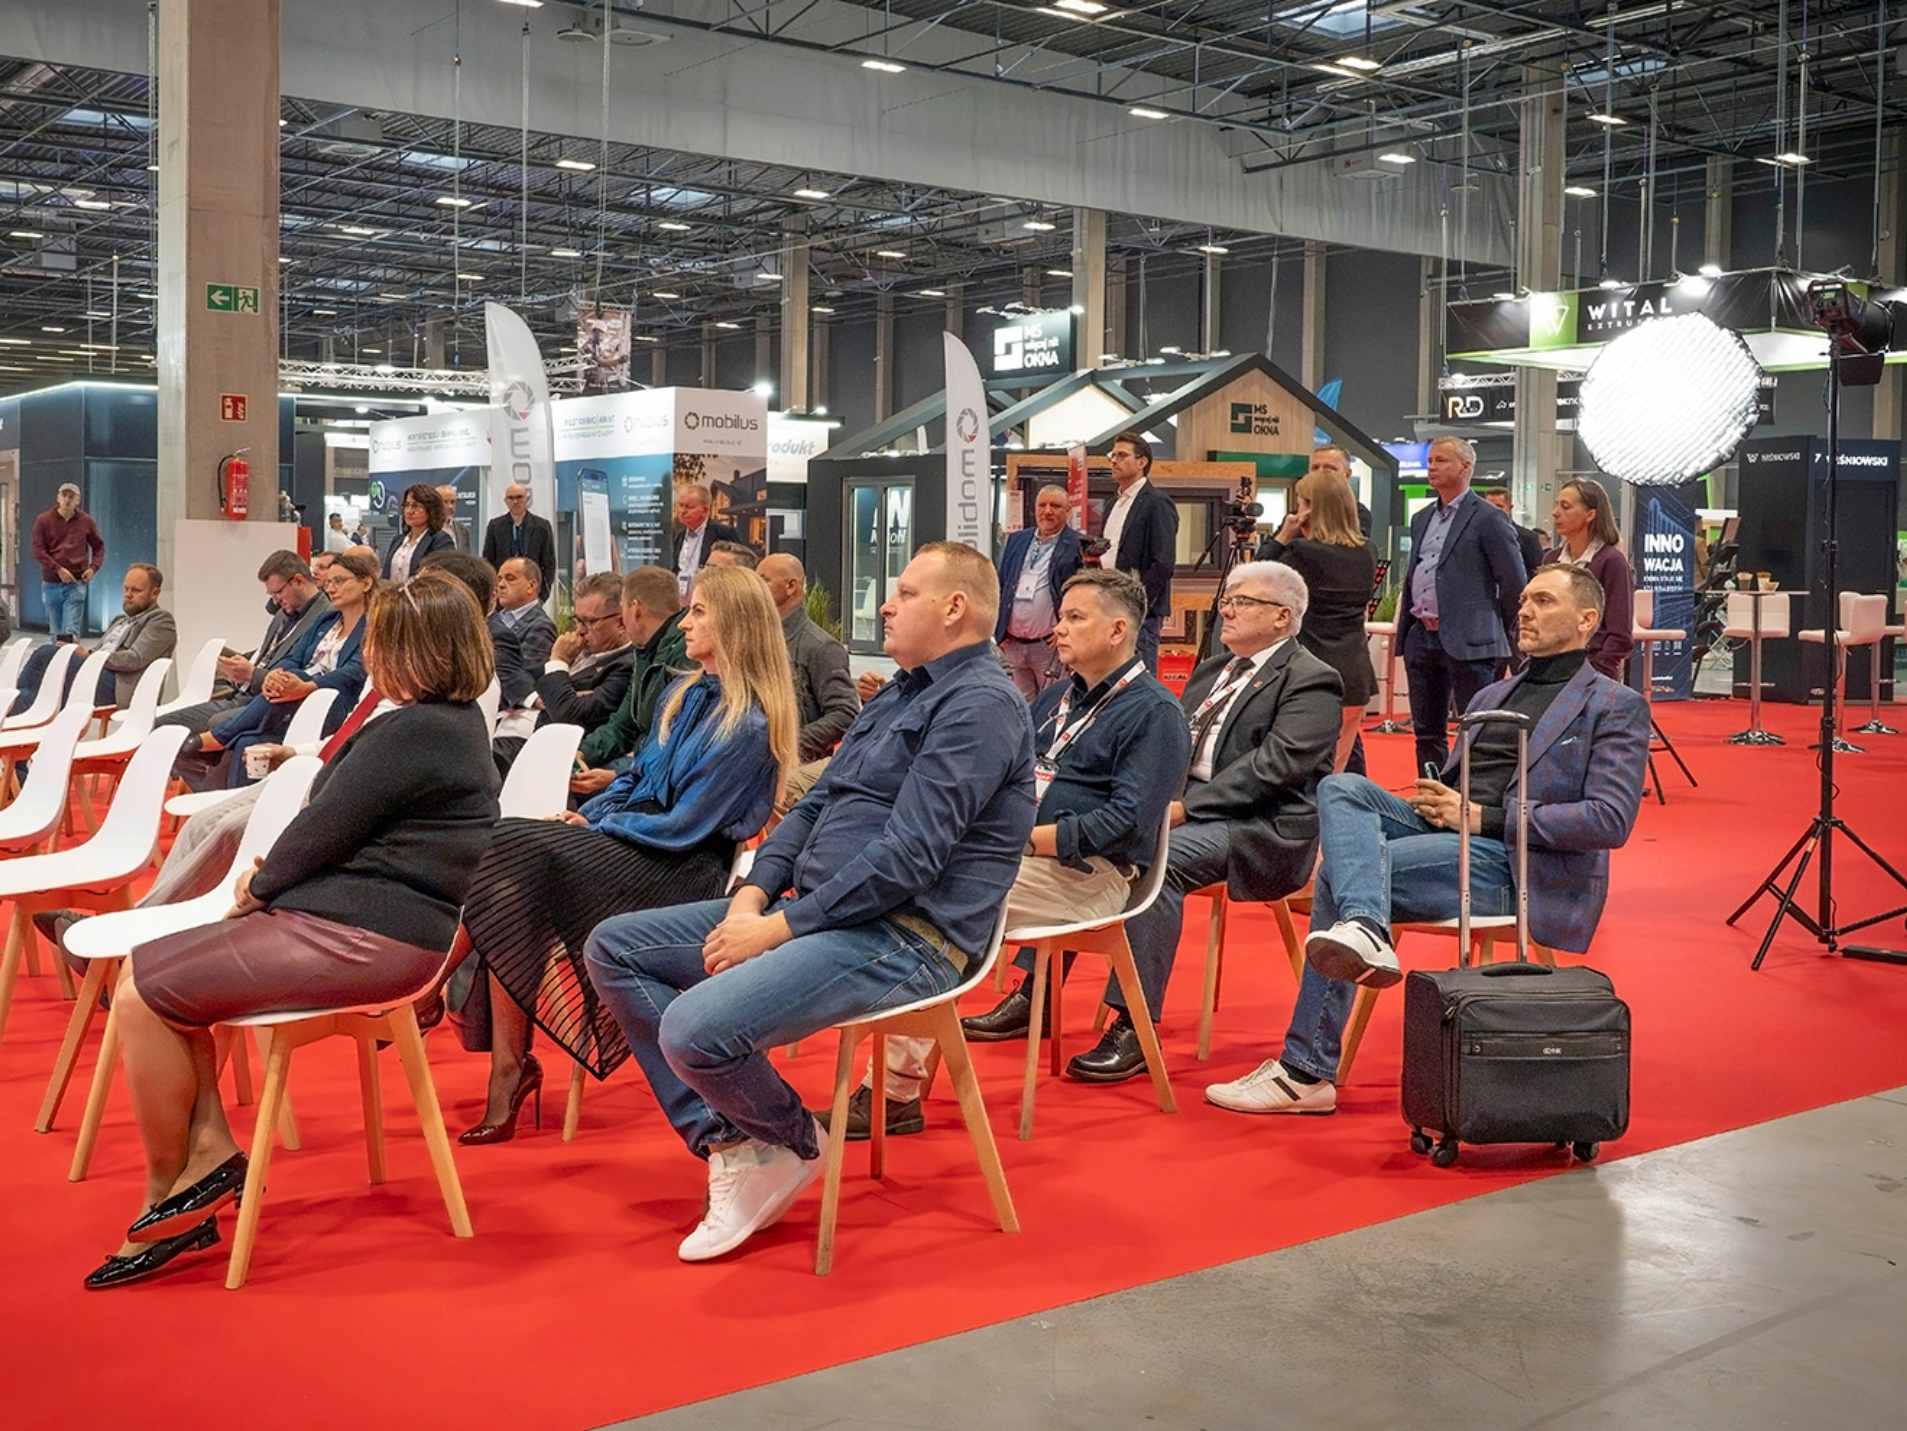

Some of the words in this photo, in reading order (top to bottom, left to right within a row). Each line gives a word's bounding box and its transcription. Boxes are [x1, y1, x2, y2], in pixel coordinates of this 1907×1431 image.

[1587, 297, 1673, 321] WITAL
[1024, 350, 1060, 368] OKNA
[701, 413, 759, 431] mobilus
[1253, 424, 1280, 436] OKNA
[1644, 533, 1685, 553] INNO
[1643, 557, 1685, 572] WACJA
